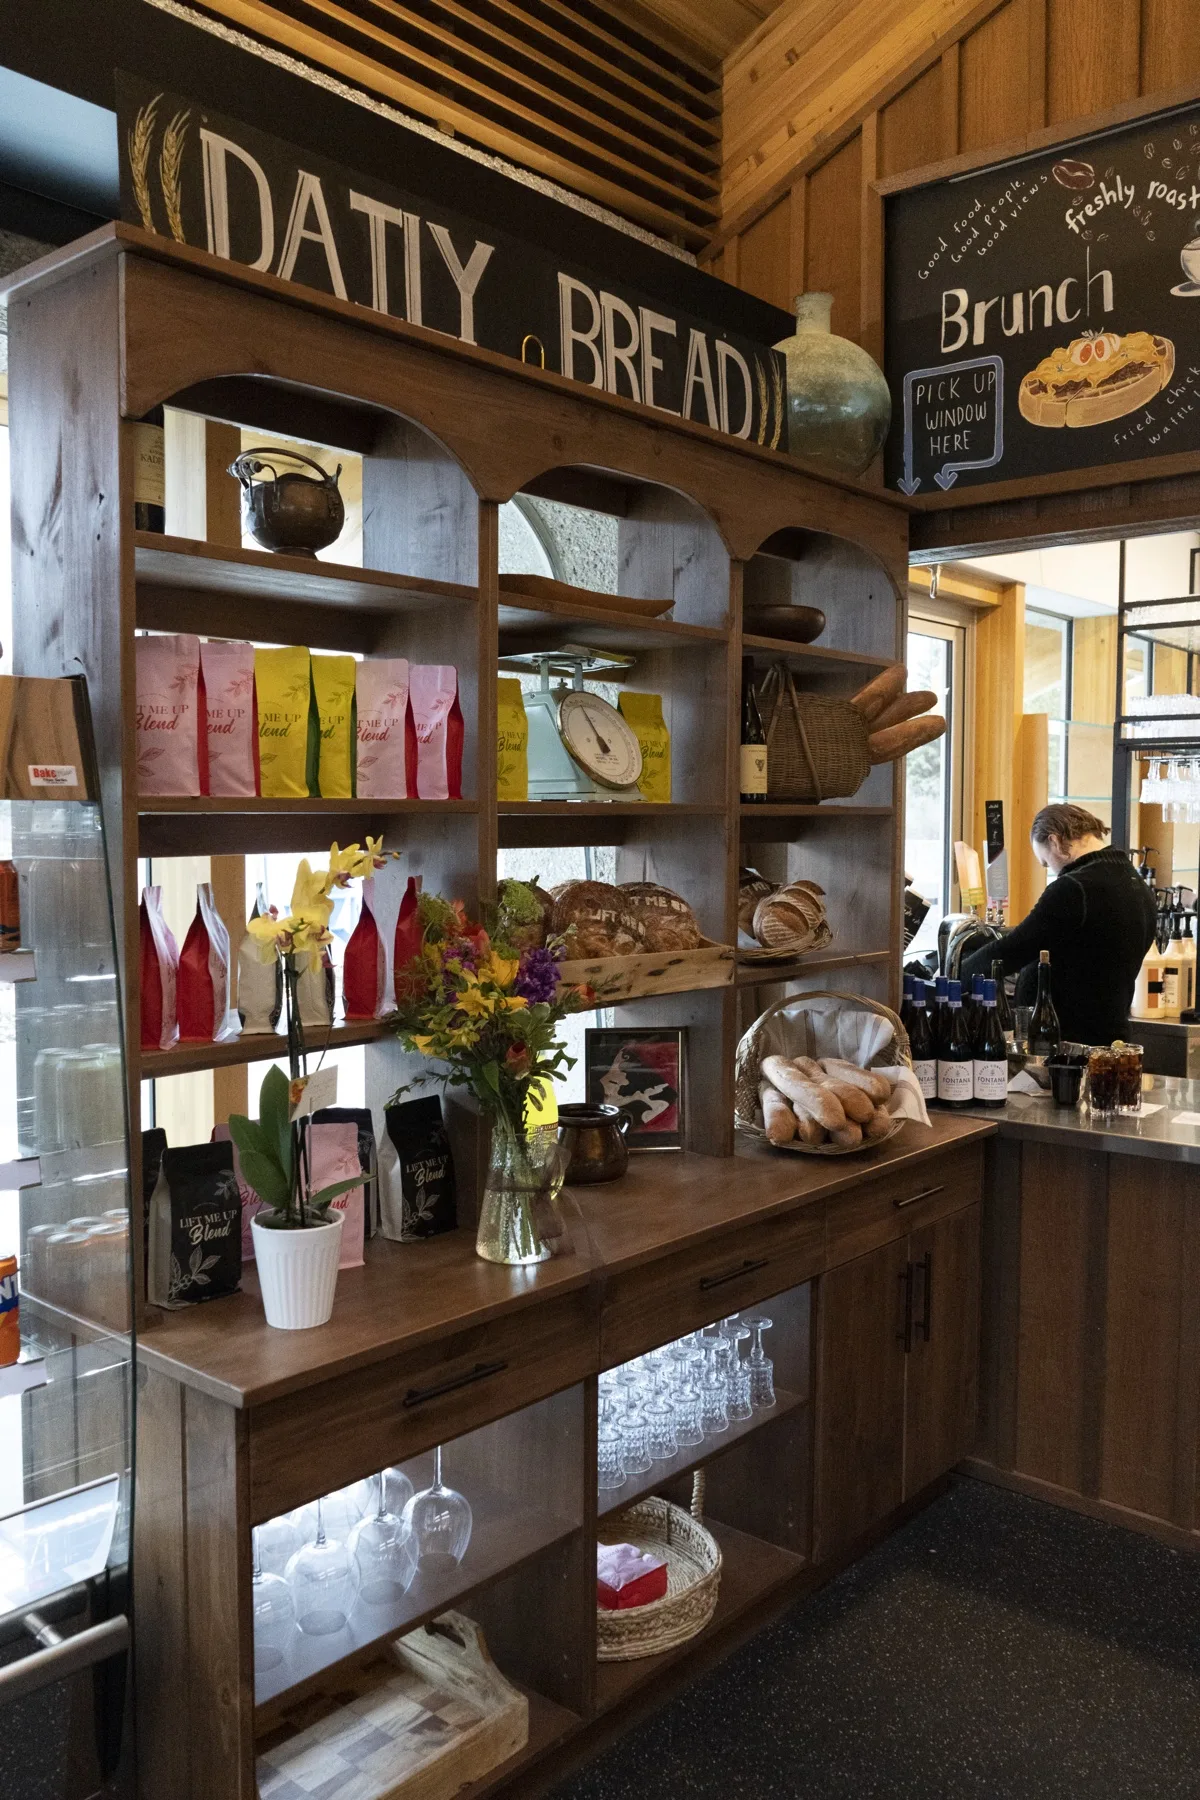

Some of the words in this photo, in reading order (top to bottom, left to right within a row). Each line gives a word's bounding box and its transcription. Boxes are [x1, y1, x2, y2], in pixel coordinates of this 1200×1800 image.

[977, 220, 1007, 255] Good
[1010, 175, 1048, 218] views
[1065, 175, 1135, 234] freshly
[1147, 181, 1200, 210] roast
[951, 226, 979, 262] Good
[984, 181, 1025, 226] people.
[918, 236, 948, 279] Good
[953, 198, 986, 233] food.
[941, 246, 1114, 353] Brunch
[557, 272, 752, 440] BREAD
[917, 377, 960, 405] PICK
[974, 371, 995, 394] UP
[926, 401, 987, 430] WINDOW
[1114, 410, 1156, 445] fried
[930, 430, 971, 456] HERE
[148, 705, 168, 715] ME
[172, 704, 189, 714] UP
[227, 708, 245, 719] UP
[264, 713, 281, 722] ME
[285, 713, 302, 723] UP
[328, 716, 345, 725] UP
[207, 718, 235, 735] end
[259, 722, 292, 738] lend
[384, 718, 399, 728] UP
[497, 736, 523, 753] Blend
[641, 745, 665, 760] Blend
[414, 1164, 446, 1187] Blend
[180, 1216, 202, 1229] LIFT
[204, 1212, 222, 1223] ME
[222, 1210, 238, 1221] UP
[189, 1219, 231, 1245] Blend
